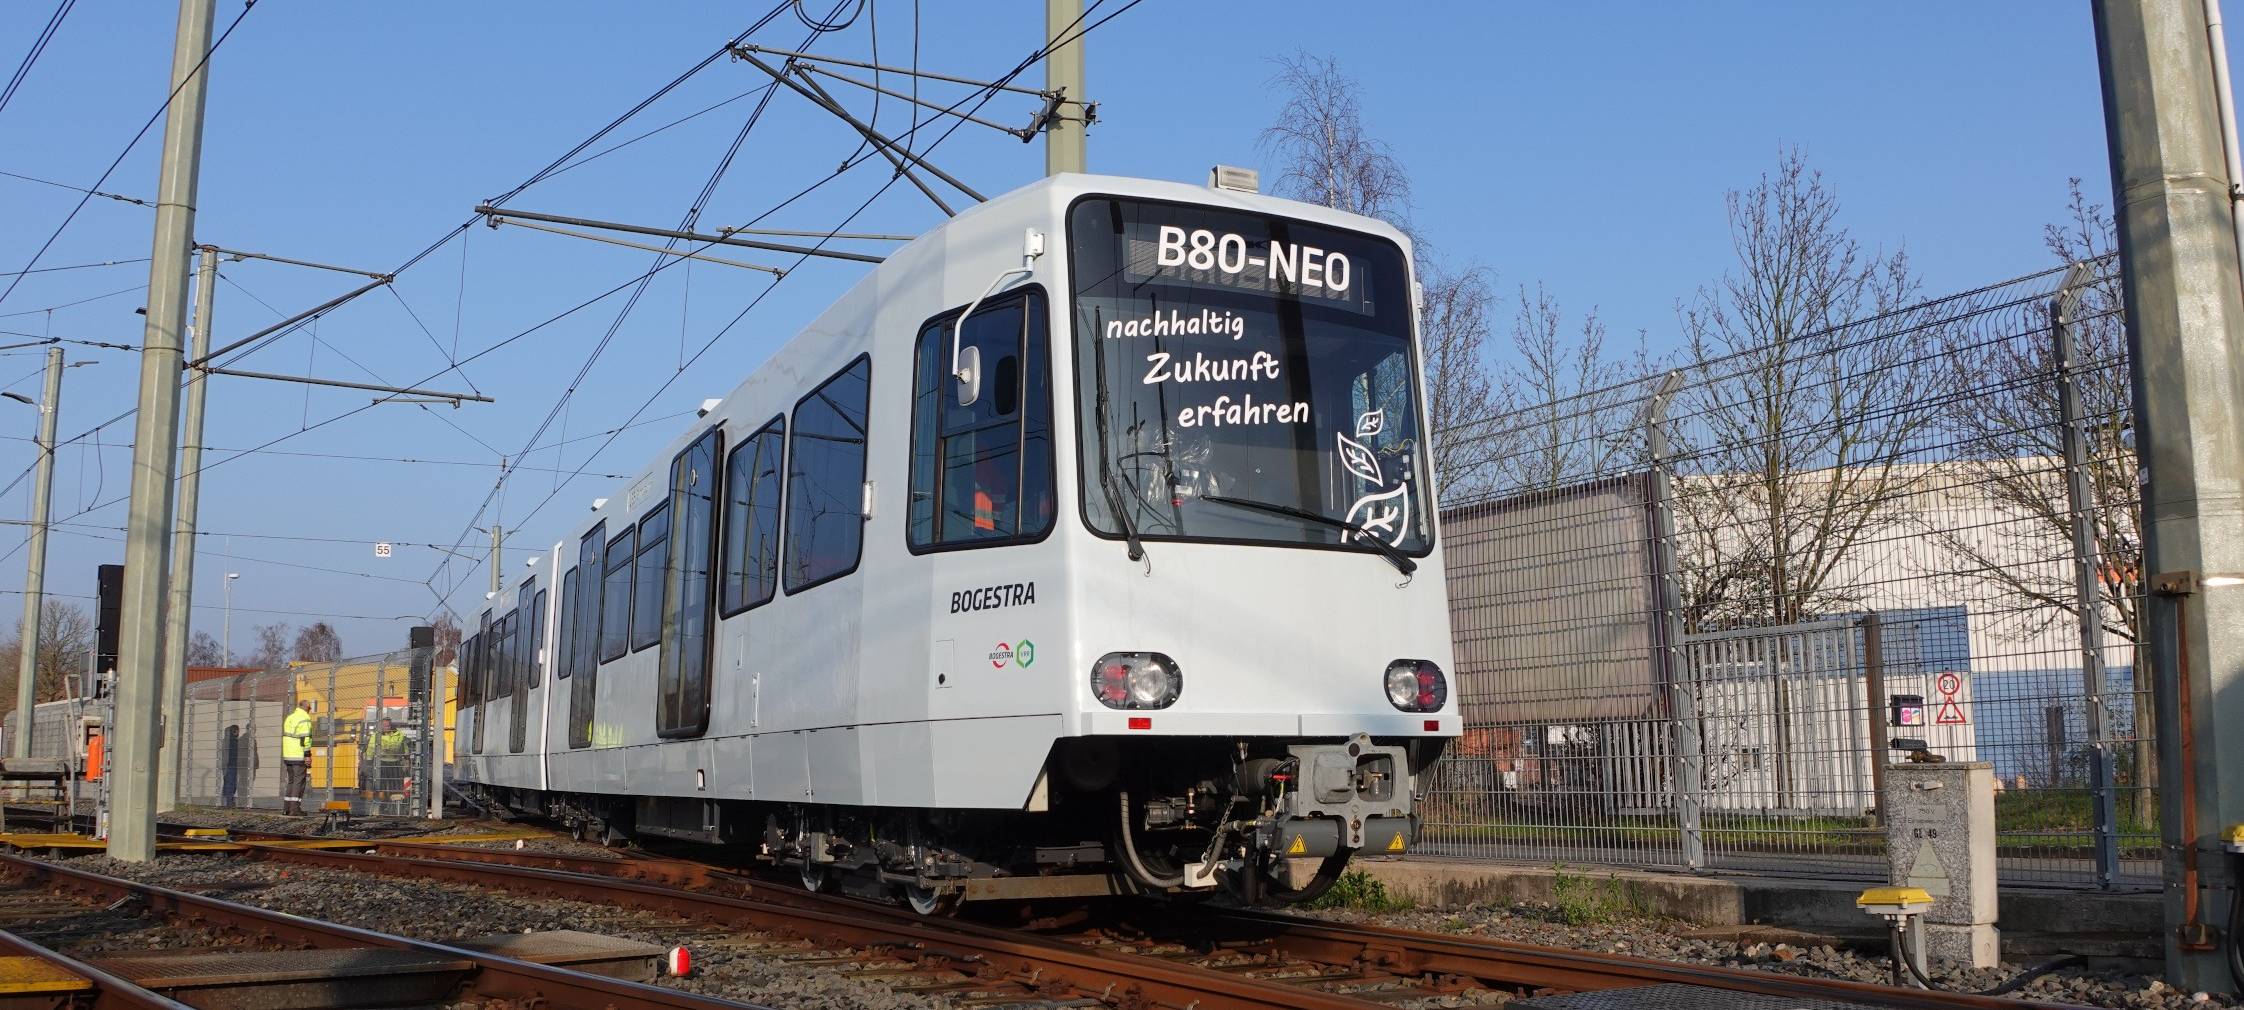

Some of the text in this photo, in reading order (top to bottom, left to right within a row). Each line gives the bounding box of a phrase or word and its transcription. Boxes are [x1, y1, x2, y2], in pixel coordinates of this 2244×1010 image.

[1157, 225, 1350, 292] B80-NEO
[1106, 308, 1244, 341] nachhaltig
[1143, 350, 1280, 385] Zukunft
[1177, 393, 1310, 428] erfahren
[377, 545, 390, 555] 55
[950, 581, 1036, 614] BOGESTRA
[988, 651, 1014, 660] BOGESTRA
[1943, 679, 1955, 690] 20
[1928, 828, 1937, 839] 49
